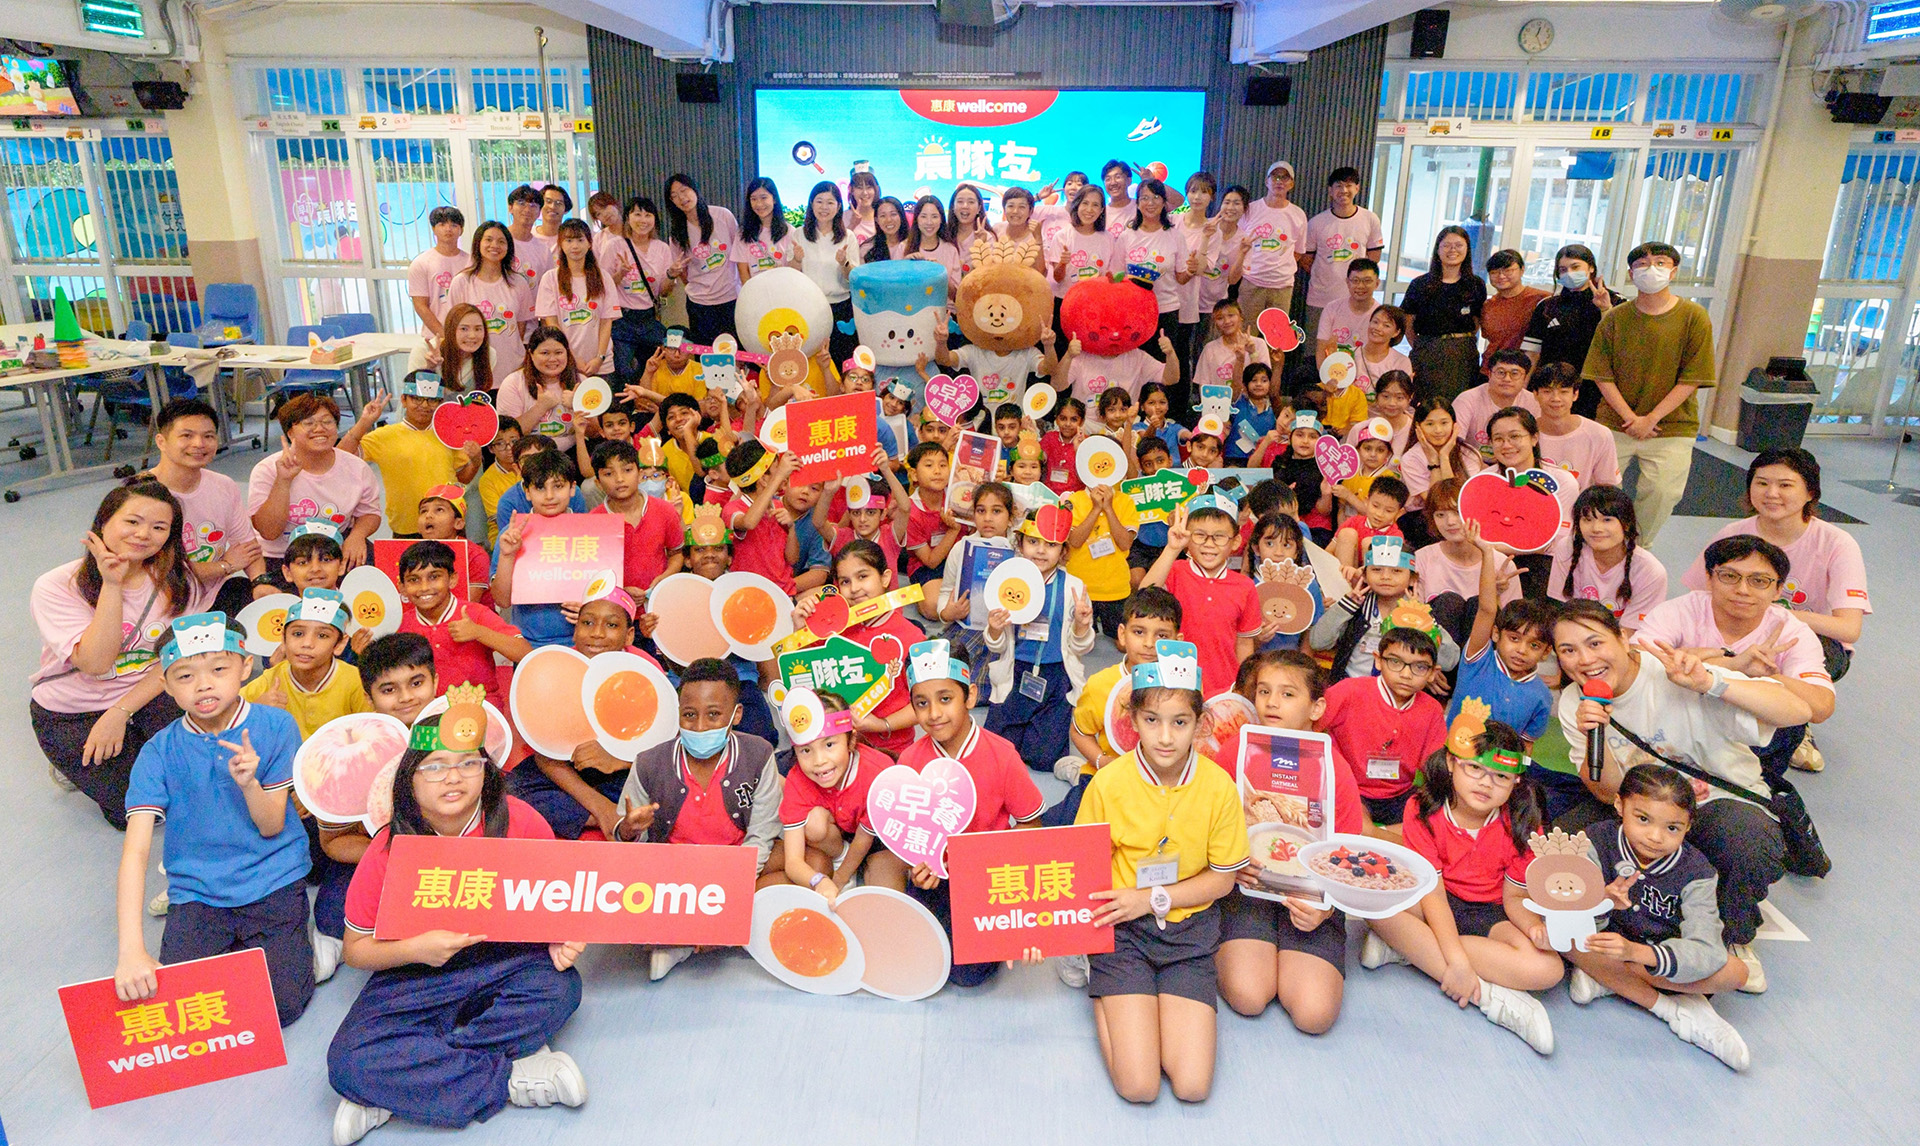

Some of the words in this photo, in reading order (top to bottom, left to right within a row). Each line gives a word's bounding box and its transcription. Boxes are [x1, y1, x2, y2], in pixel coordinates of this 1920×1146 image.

[930, 99, 955, 113] 惠康
[956, 99, 1028, 114] wellcome
[381, 117, 388, 126] 2
[578, 121, 592, 131] 1C
[1456, 122, 1463, 131] 4
[1680, 124, 1687, 135] 5
[1595, 128, 1611, 137] 1B
[1715, 130, 1731, 139] 1A
[808, 415, 858, 447] 惠康
[801, 444, 867, 465] wellcome
[539, 536, 600, 564] 惠康
[869, 681, 888, 699] GO!
[1271, 772, 1299, 782] INSTANT
[1271, 779, 1299, 789] OATMEAL
[987, 860, 1077, 905] 惠康
[411, 867, 498, 910] 惠康
[503, 871, 726, 916] wellcome
[973, 908, 1092, 932] wellcome
[115, 990, 232, 1046] 惠康
[107, 1030, 256, 1075] wellcome
